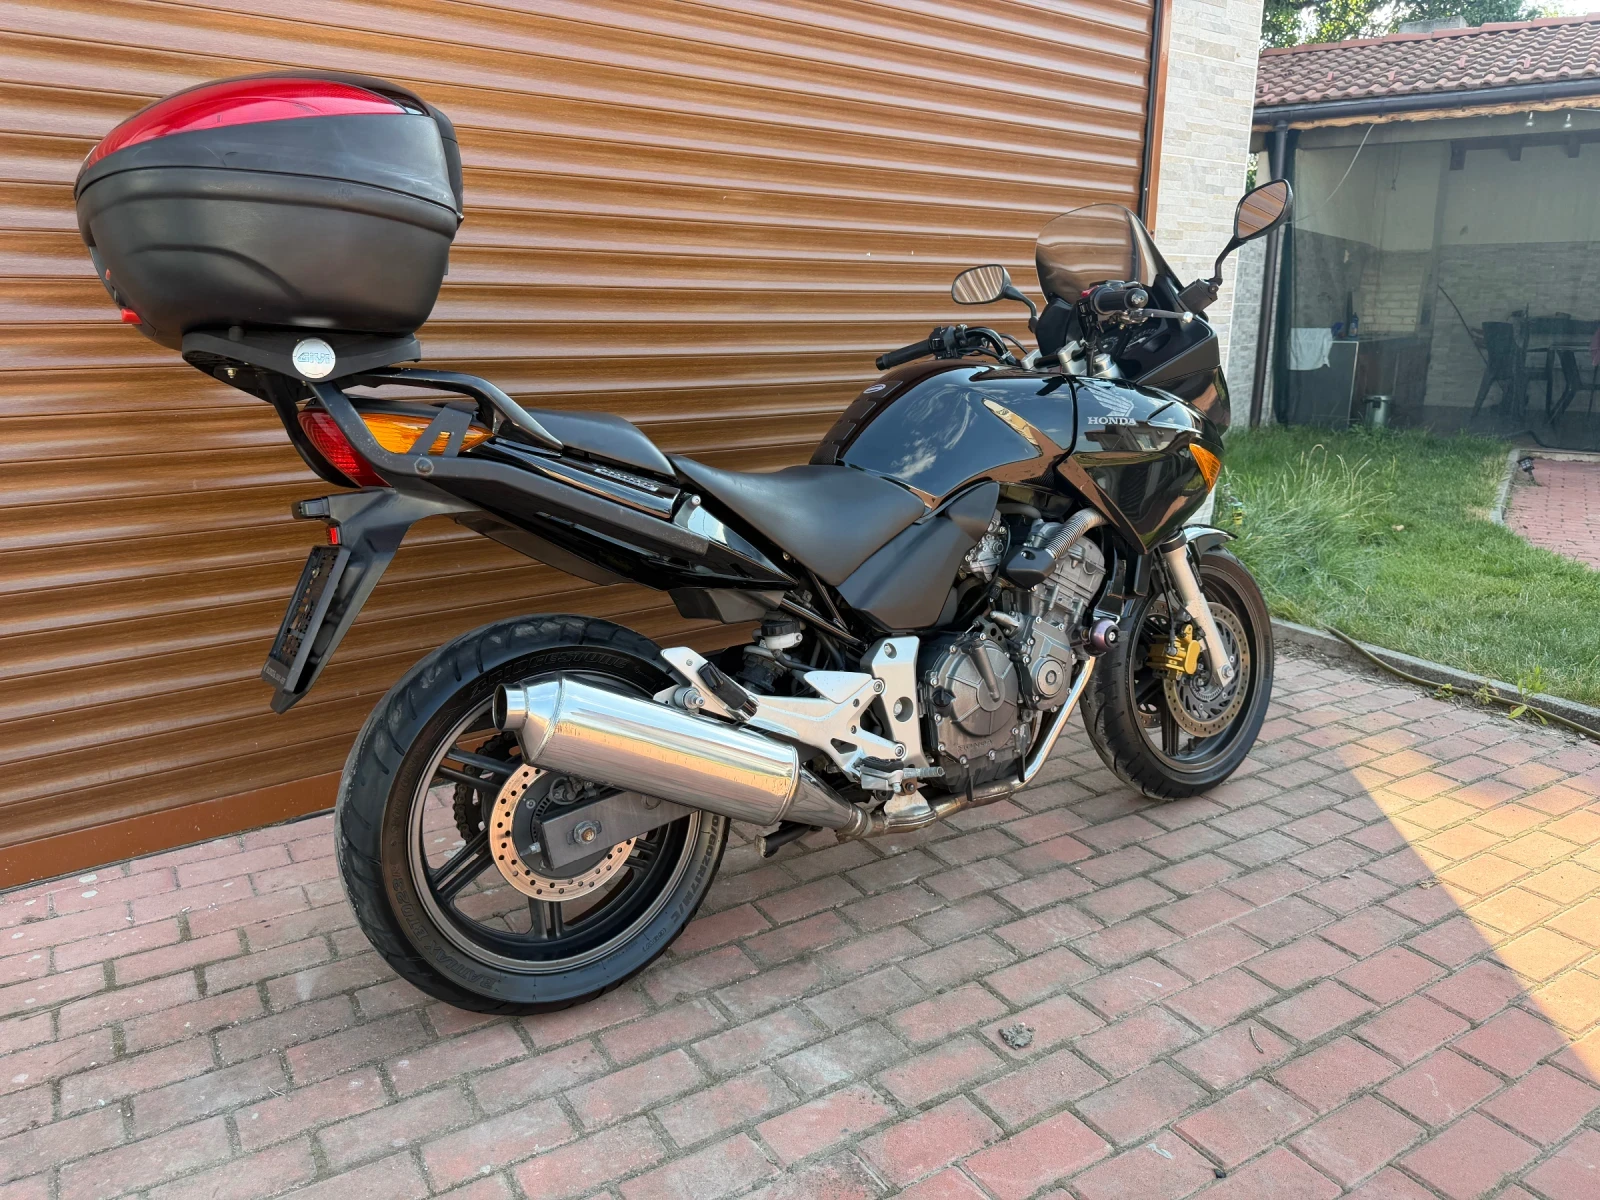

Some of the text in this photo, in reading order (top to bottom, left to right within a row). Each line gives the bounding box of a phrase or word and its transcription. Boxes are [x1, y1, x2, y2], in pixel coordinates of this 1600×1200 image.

[297, 351, 331, 364] GIVI
[1087, 416, 1137, 425] HONDA
[424, 940, 496, 989] BATTLAX
